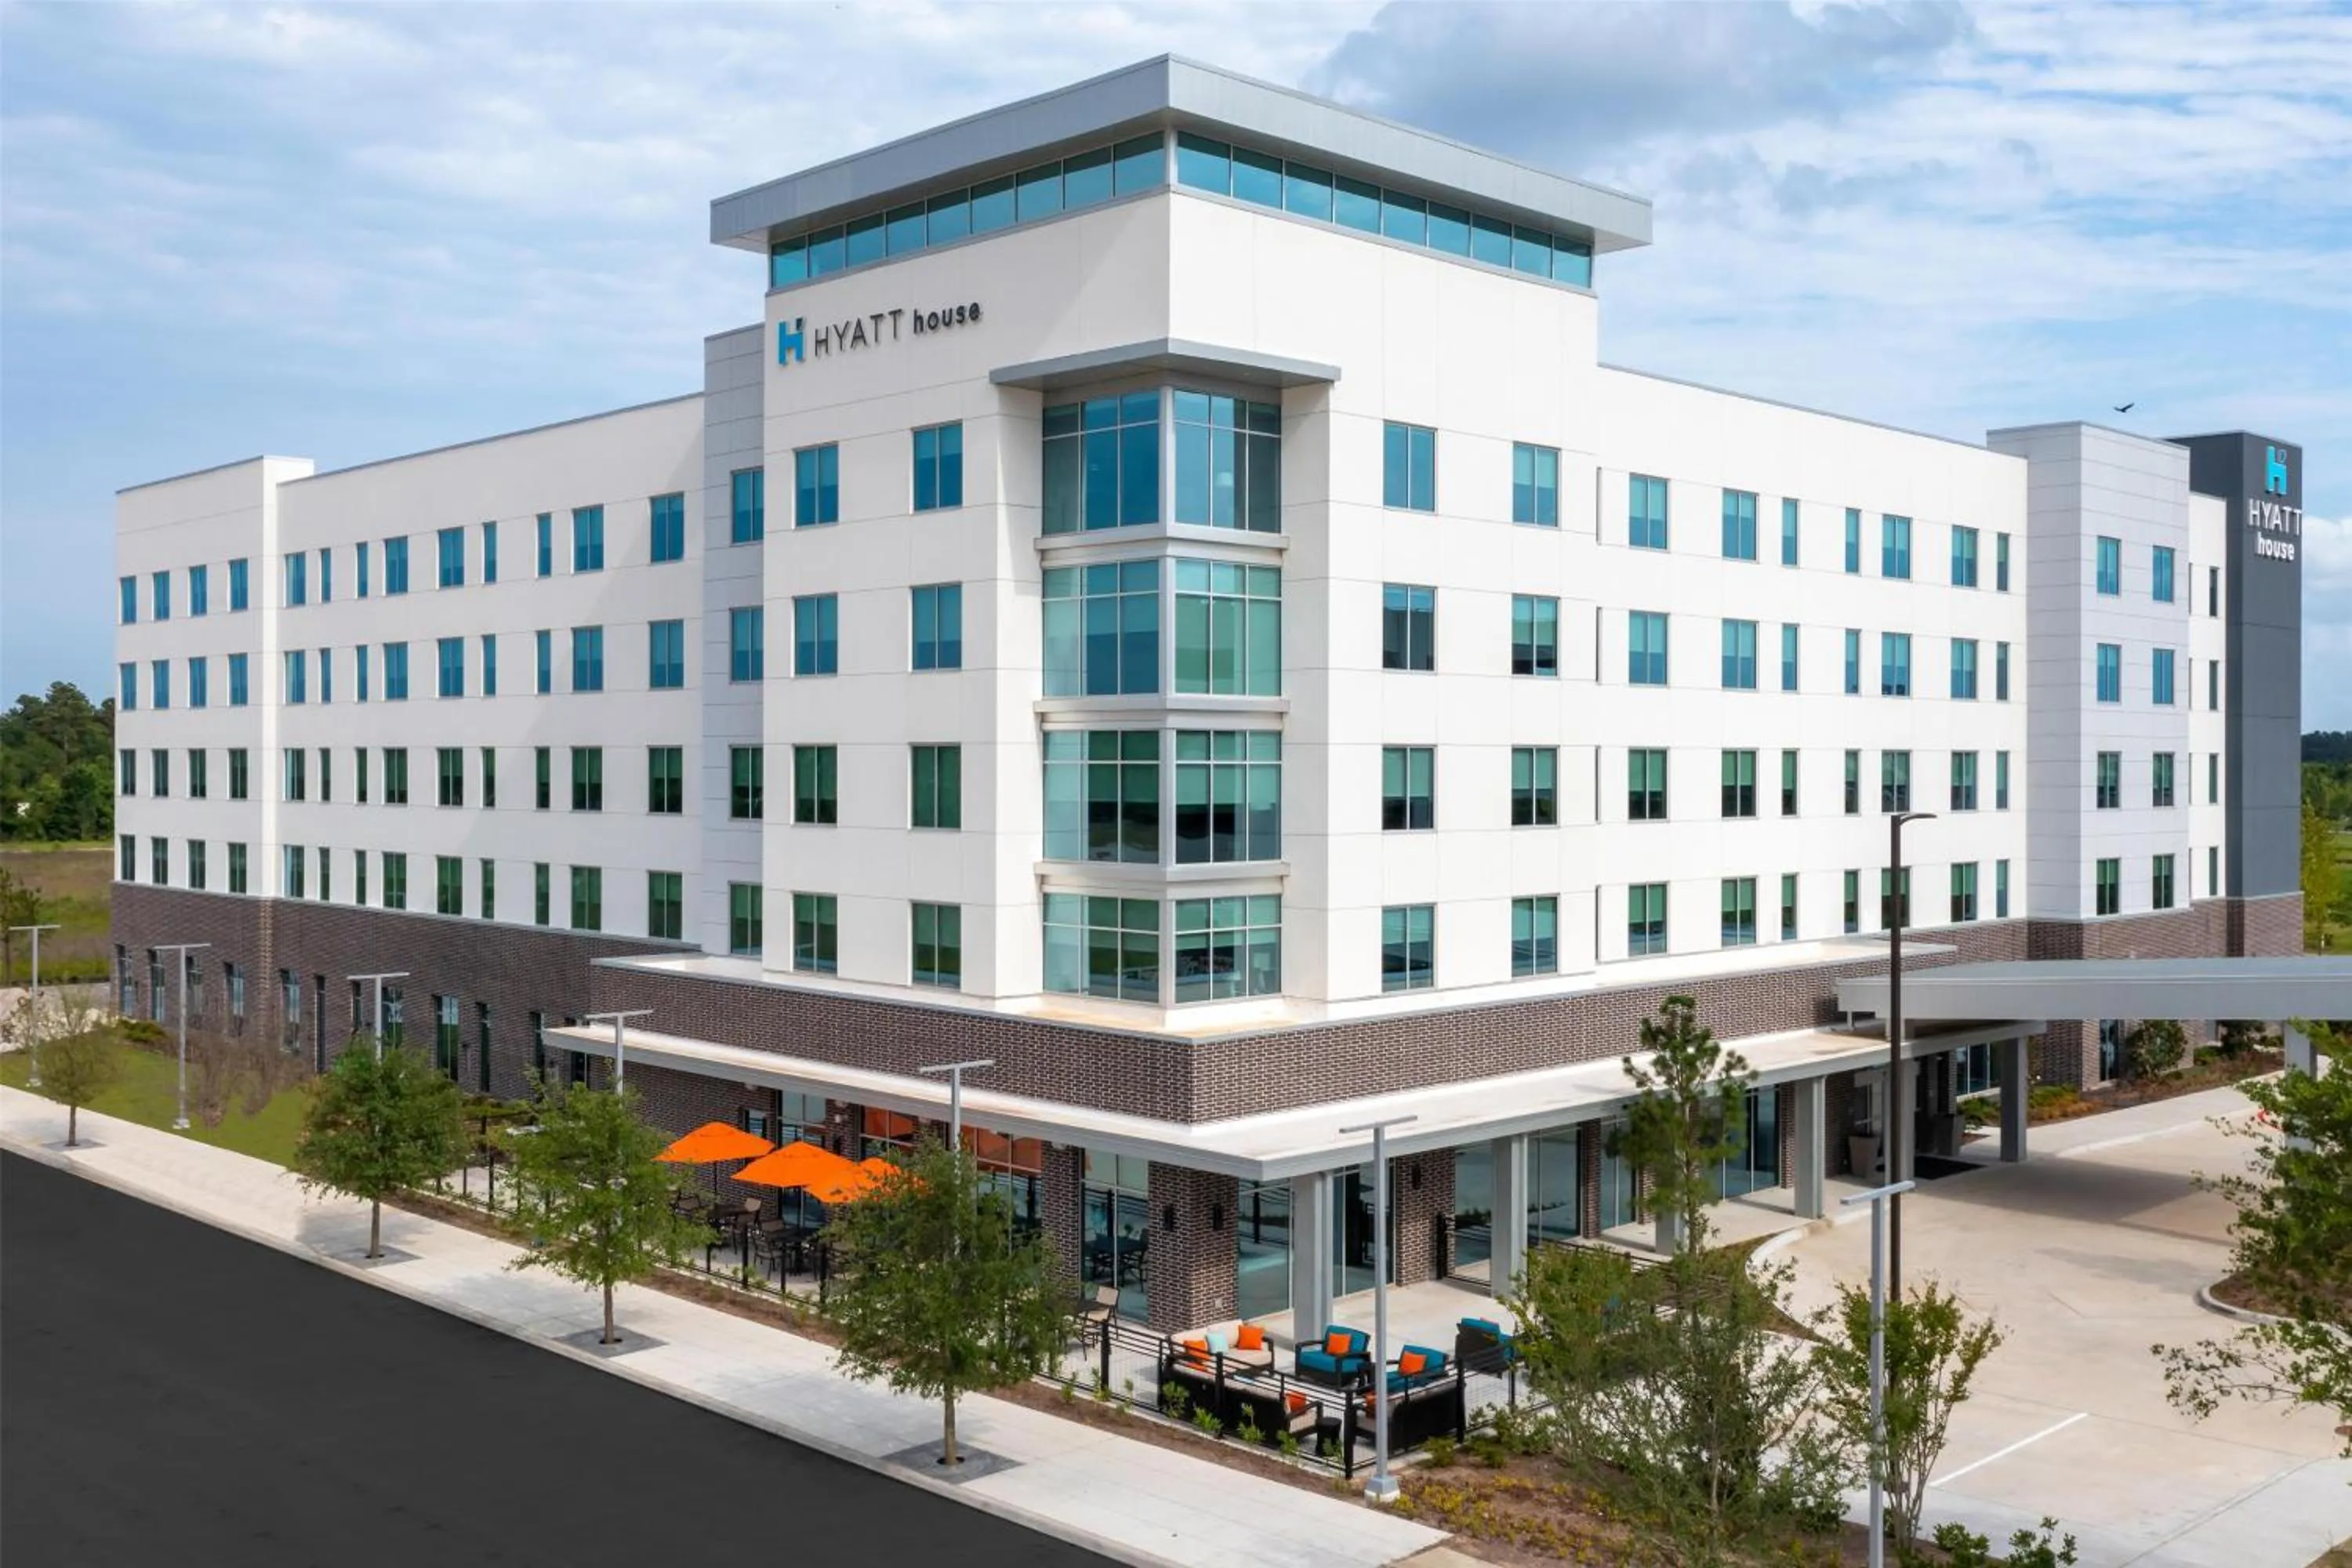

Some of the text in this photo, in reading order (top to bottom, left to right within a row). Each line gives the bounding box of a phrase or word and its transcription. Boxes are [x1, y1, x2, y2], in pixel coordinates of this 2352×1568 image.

[814, 308, 903, 357] HYATT
[913, 302, 982, 334] house
[2249, 498, 2302, 536] HYATT
[2257, 531, 2295, 561] house
